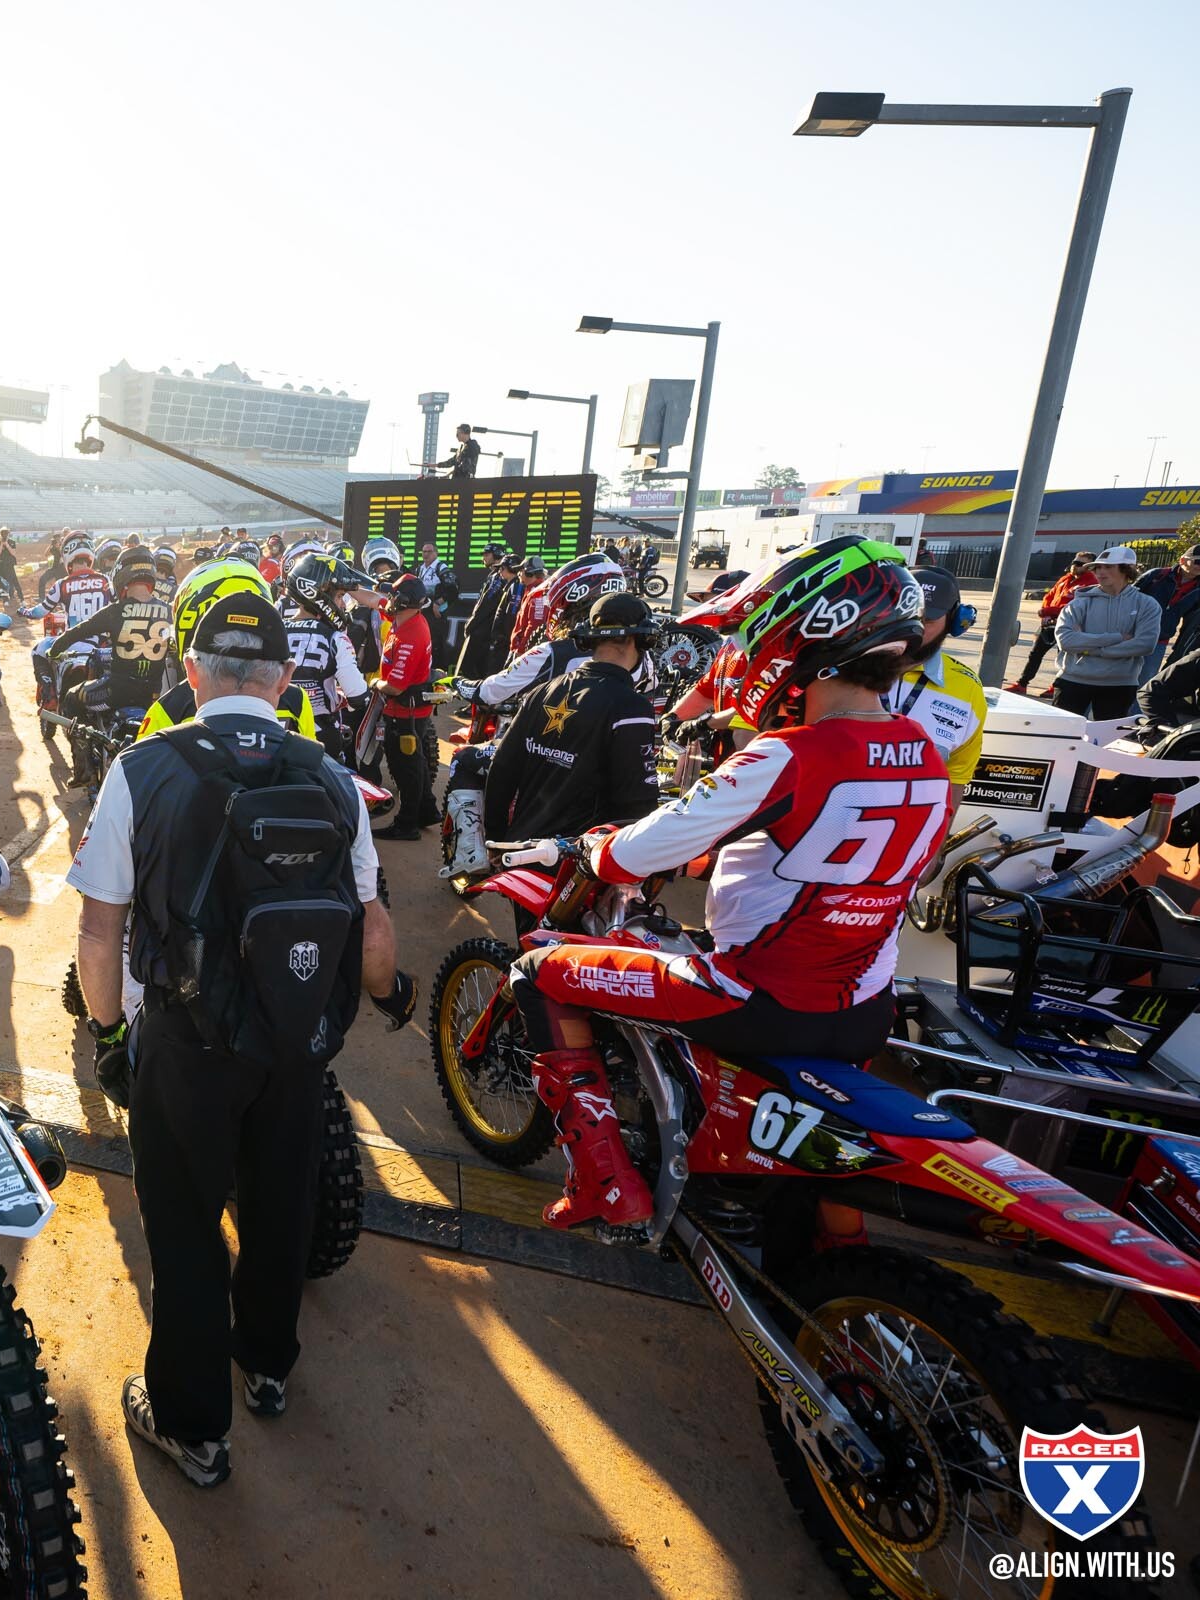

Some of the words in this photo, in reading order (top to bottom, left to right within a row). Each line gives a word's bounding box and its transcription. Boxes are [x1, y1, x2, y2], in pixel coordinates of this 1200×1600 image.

[920, 475, 994, 489] SUNOCO
[636, 492, 670, 501] ambetter
[65, 579, 103, 593] HICKS
[68, 591, 105, 627] 460
[745, 556, 845, 645] FMF
[121, 603, 169, 618] SMITH
[229, 615, 257, 624] PIRELLI
[800, 596, 860, 639] 6D
[115, 619, 171, 661] 58
[868, 740, 927, 766] PARK
[985, 763, 1043, 776] ROCKSTAR
[972, 786, 1033, 801] Husqvarna
[774, 779, 951, 886] 67
[264, 851, 322, 864] FOX
[848, 896, 904, 907] HONDA
[580, 966, 655, 984] MOOSE
[580, 979, 655, 998] RACING
[800, 1070, 850, 1103] GUTS
[751, 1091, 824, 1158] 67
[746, 1151, 774, 1169] MOTUL
[931, 1159, 1006, 1205] PIRELLI
[741, 1328, 821, 1421] SUNSTAR
